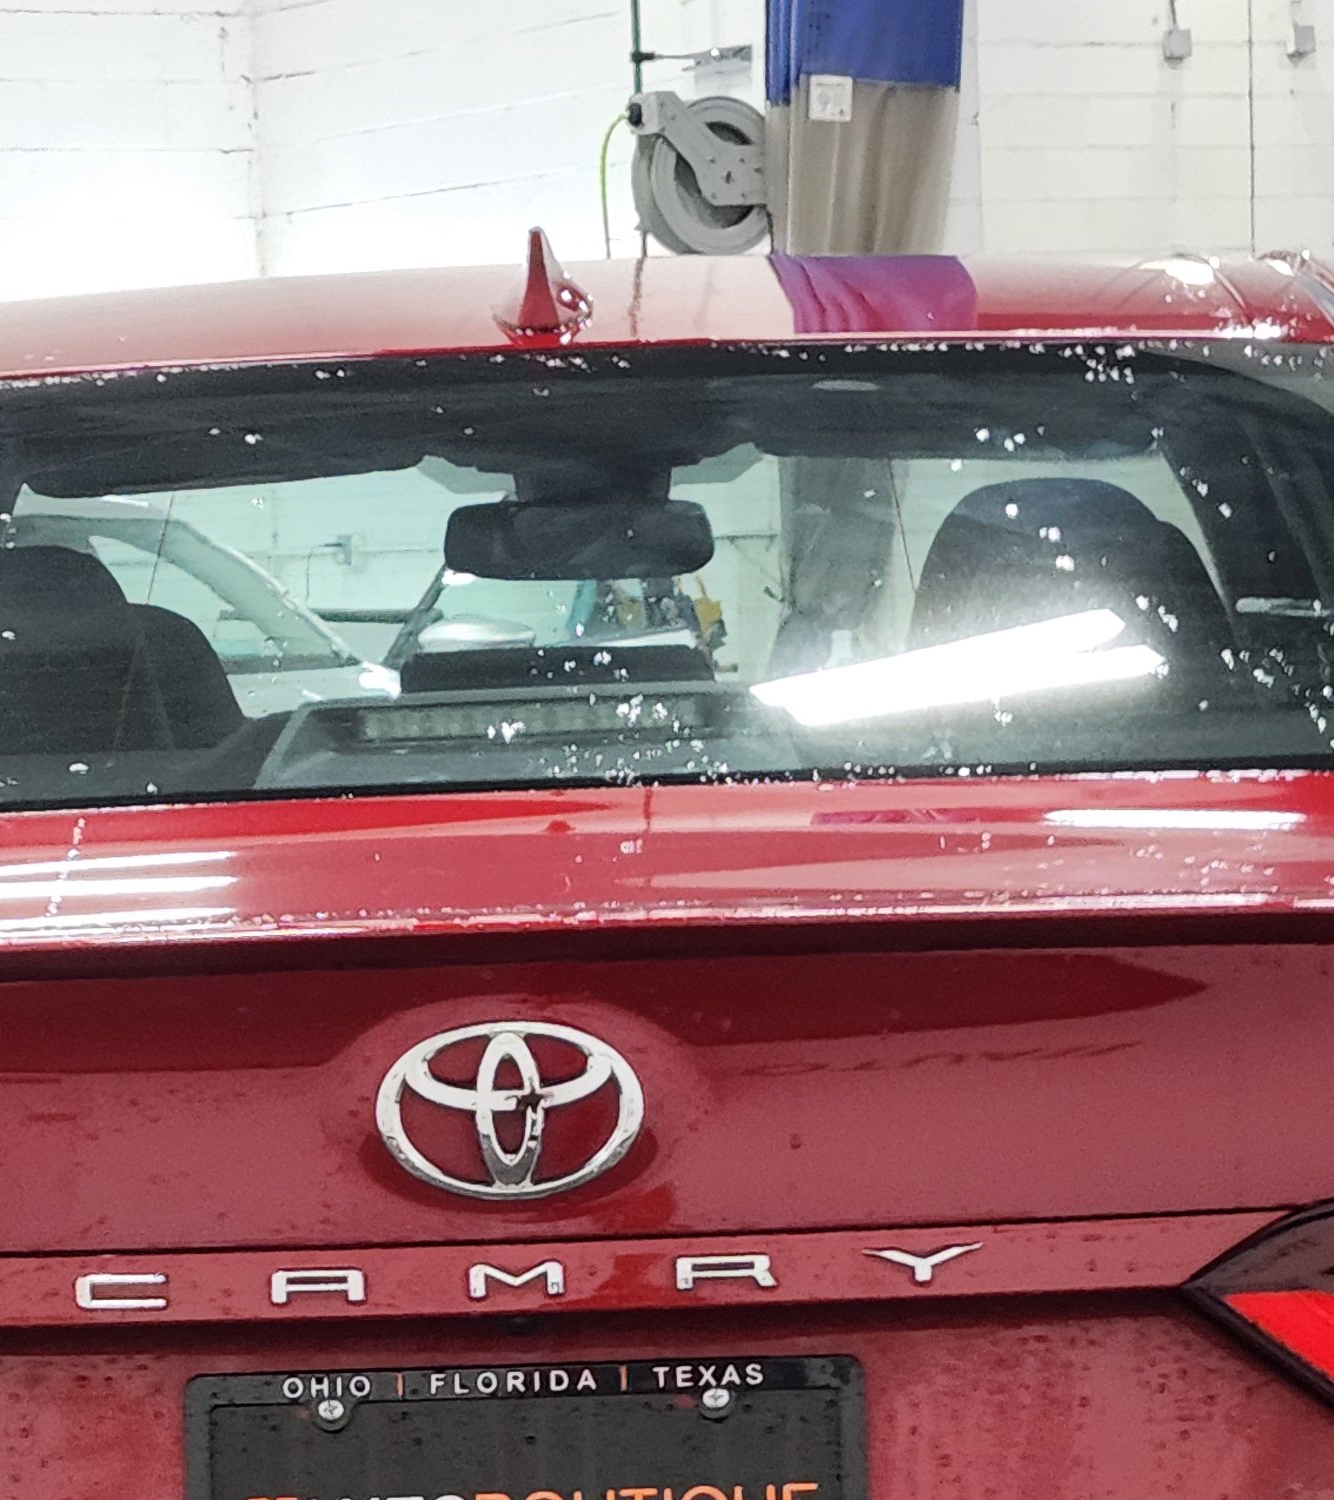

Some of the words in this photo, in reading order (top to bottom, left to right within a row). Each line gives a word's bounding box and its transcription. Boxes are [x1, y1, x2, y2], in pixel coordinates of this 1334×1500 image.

[75, 1242, 983, 1309] CAMRY
[282, 1374, 371, 1399] OHIO
[430, 1368, 597, 1395] FLORIDA
[652, 1362, 764, 1388] TEXAS
